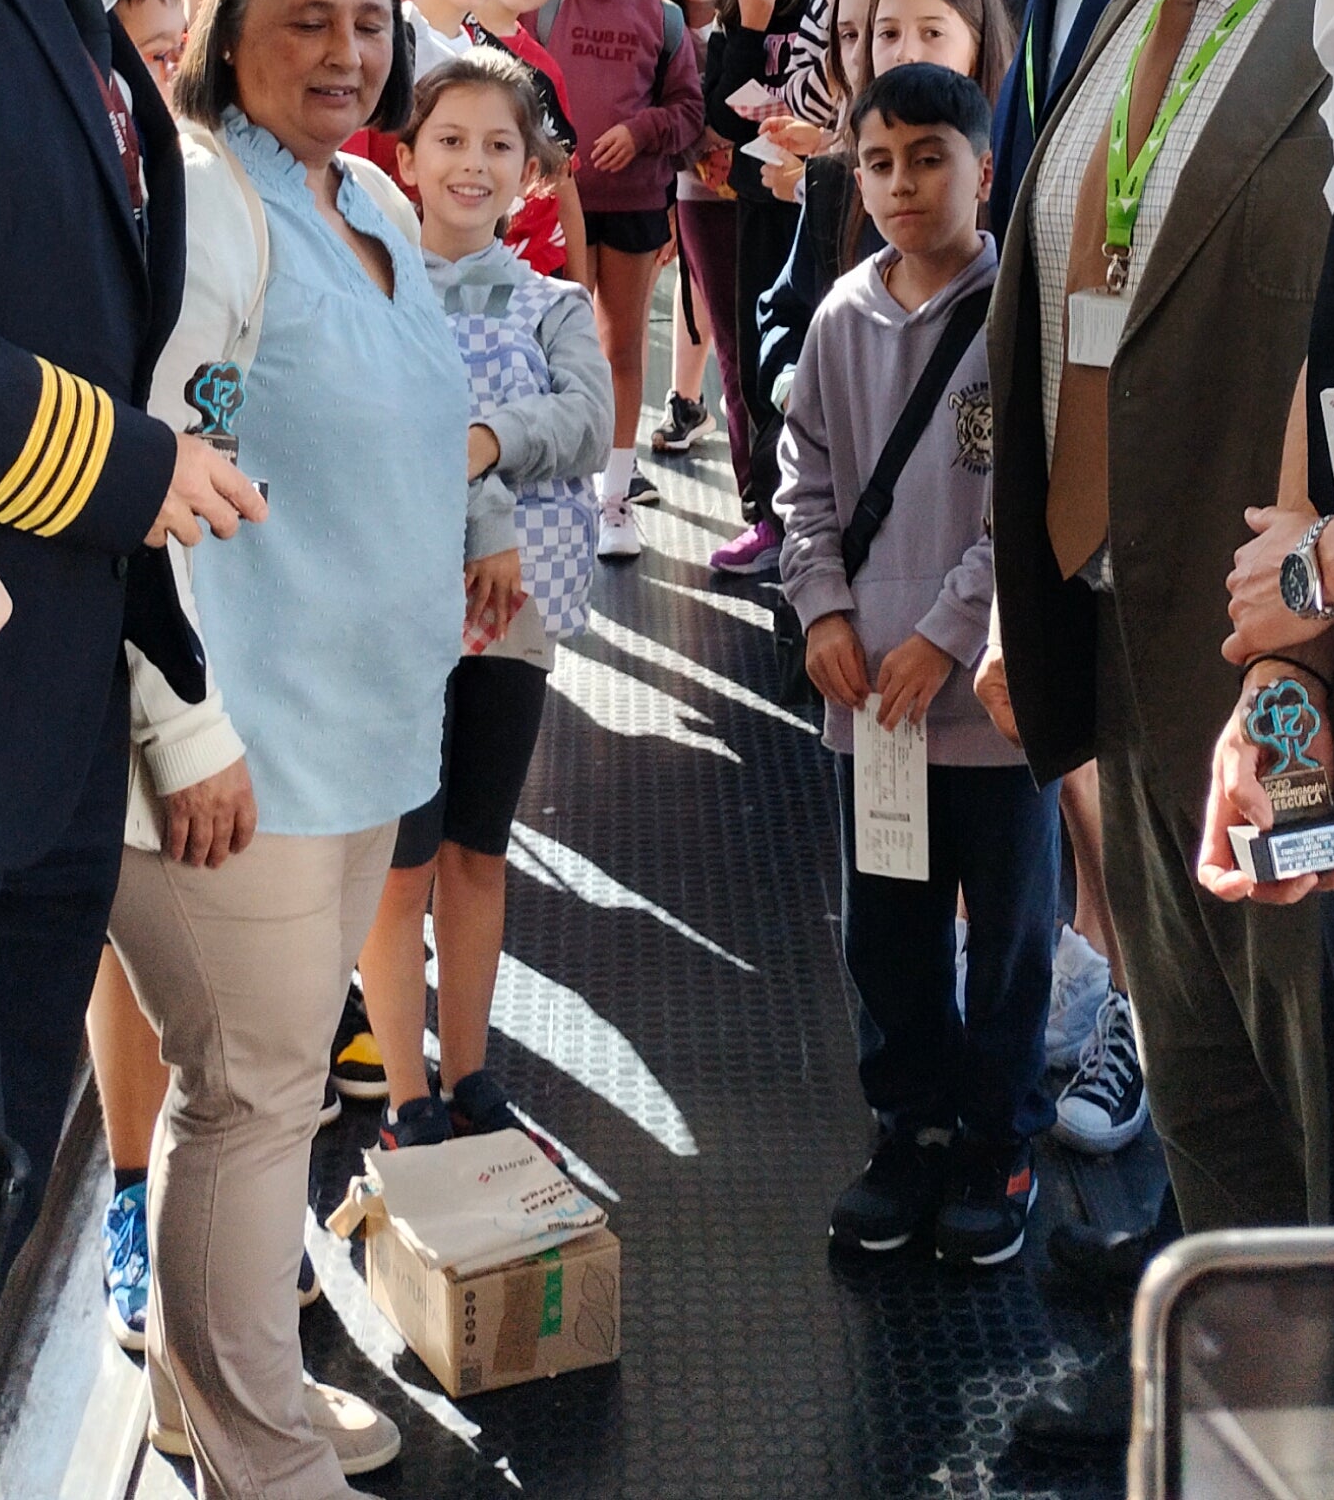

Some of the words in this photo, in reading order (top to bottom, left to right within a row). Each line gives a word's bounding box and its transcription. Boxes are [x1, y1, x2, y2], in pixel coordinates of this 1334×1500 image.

[571, 26, 615, 44] CLUB
[618, 31, 640, 47] DE
[572, 42, 636, 62] BALLET
[1274, 793, 1323, 811] ESCUELA
